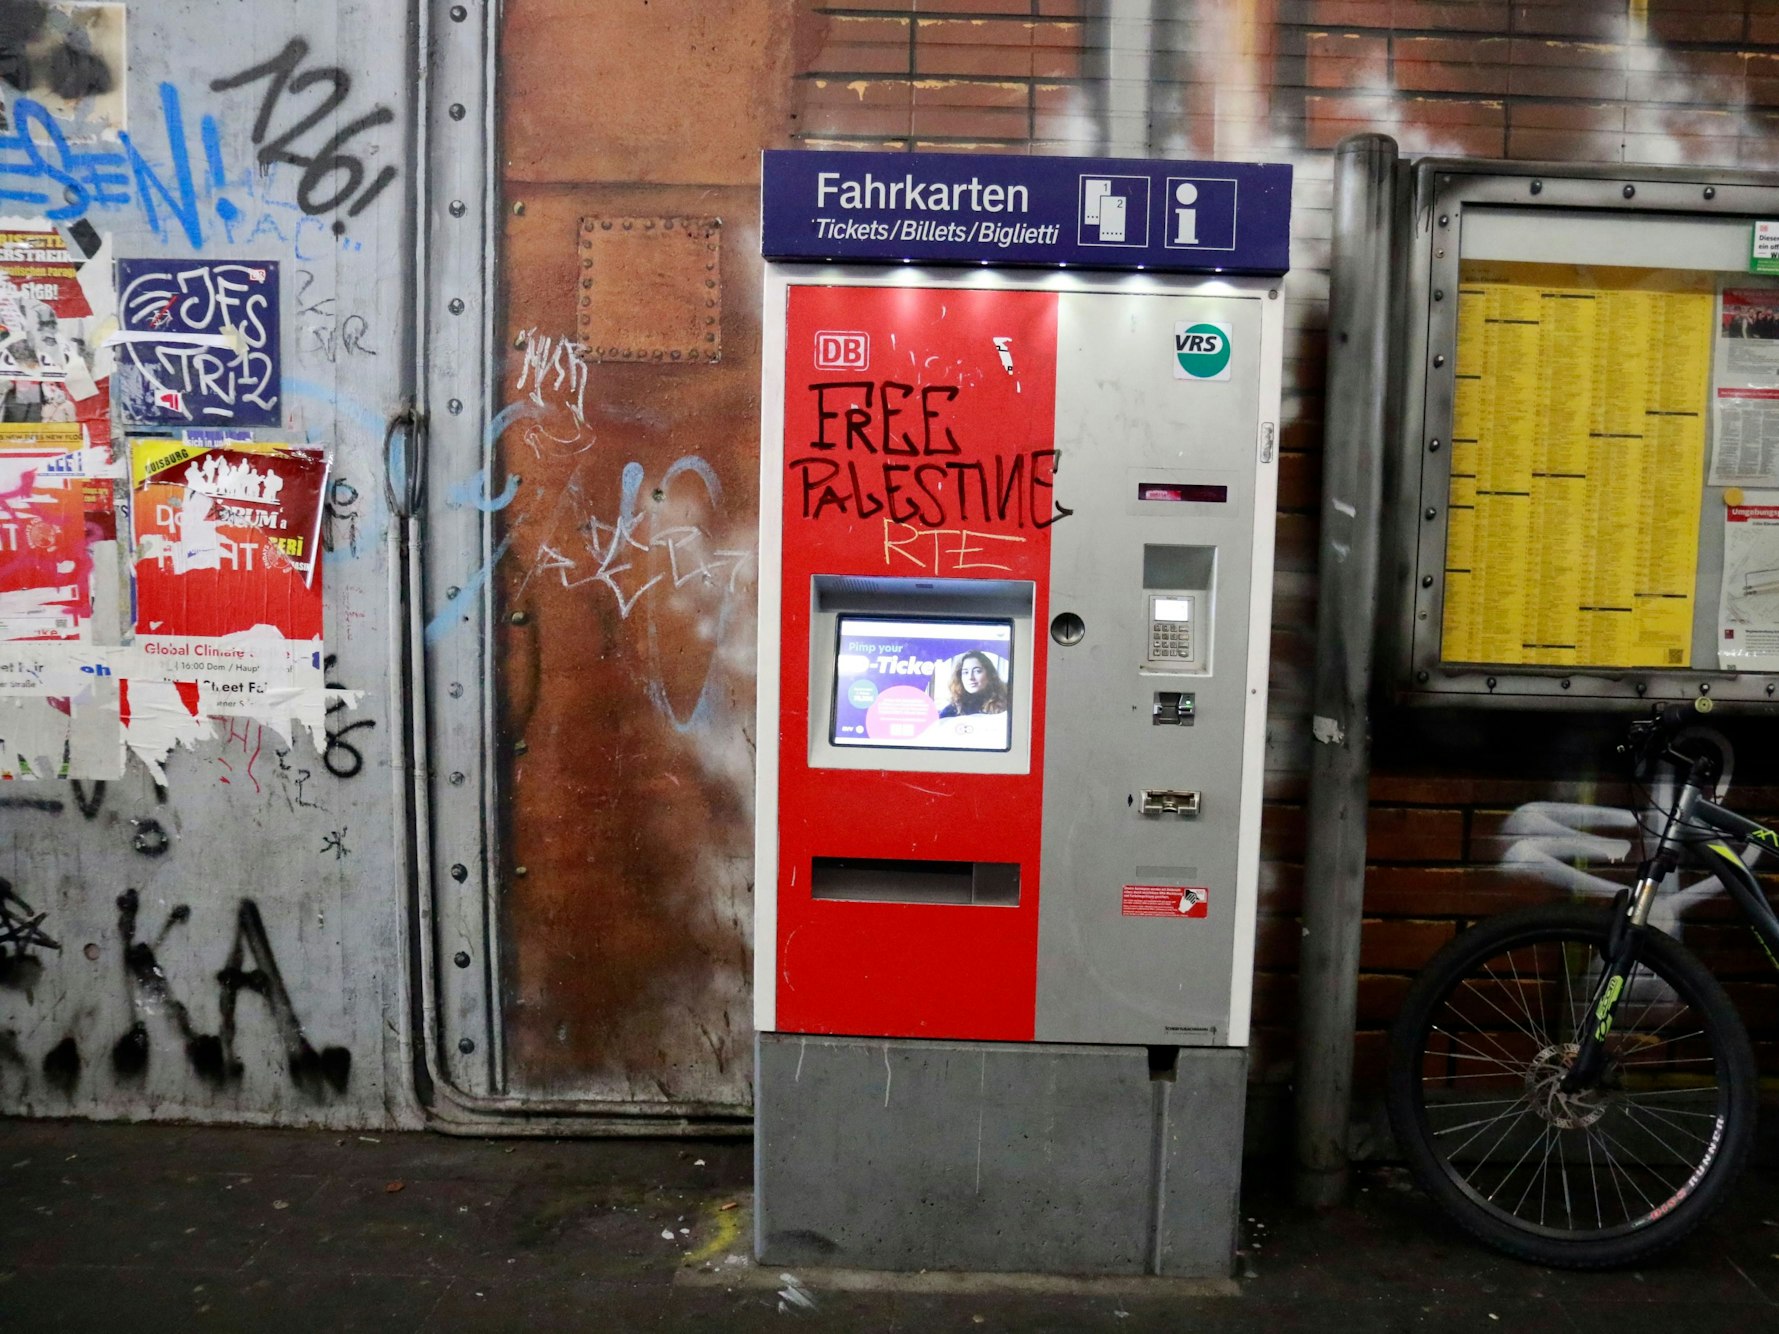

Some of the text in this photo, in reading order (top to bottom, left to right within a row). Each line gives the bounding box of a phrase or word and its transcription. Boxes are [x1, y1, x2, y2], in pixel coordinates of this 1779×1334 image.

[817, 172, 1029, 213] Fahrkarten
[822, 338, 861, 363] DB
[1175, 334, 1218, 352] VRS
[808, 380, 962, 457] FREE
[789, 448, 1074, 530] PALESTINE
